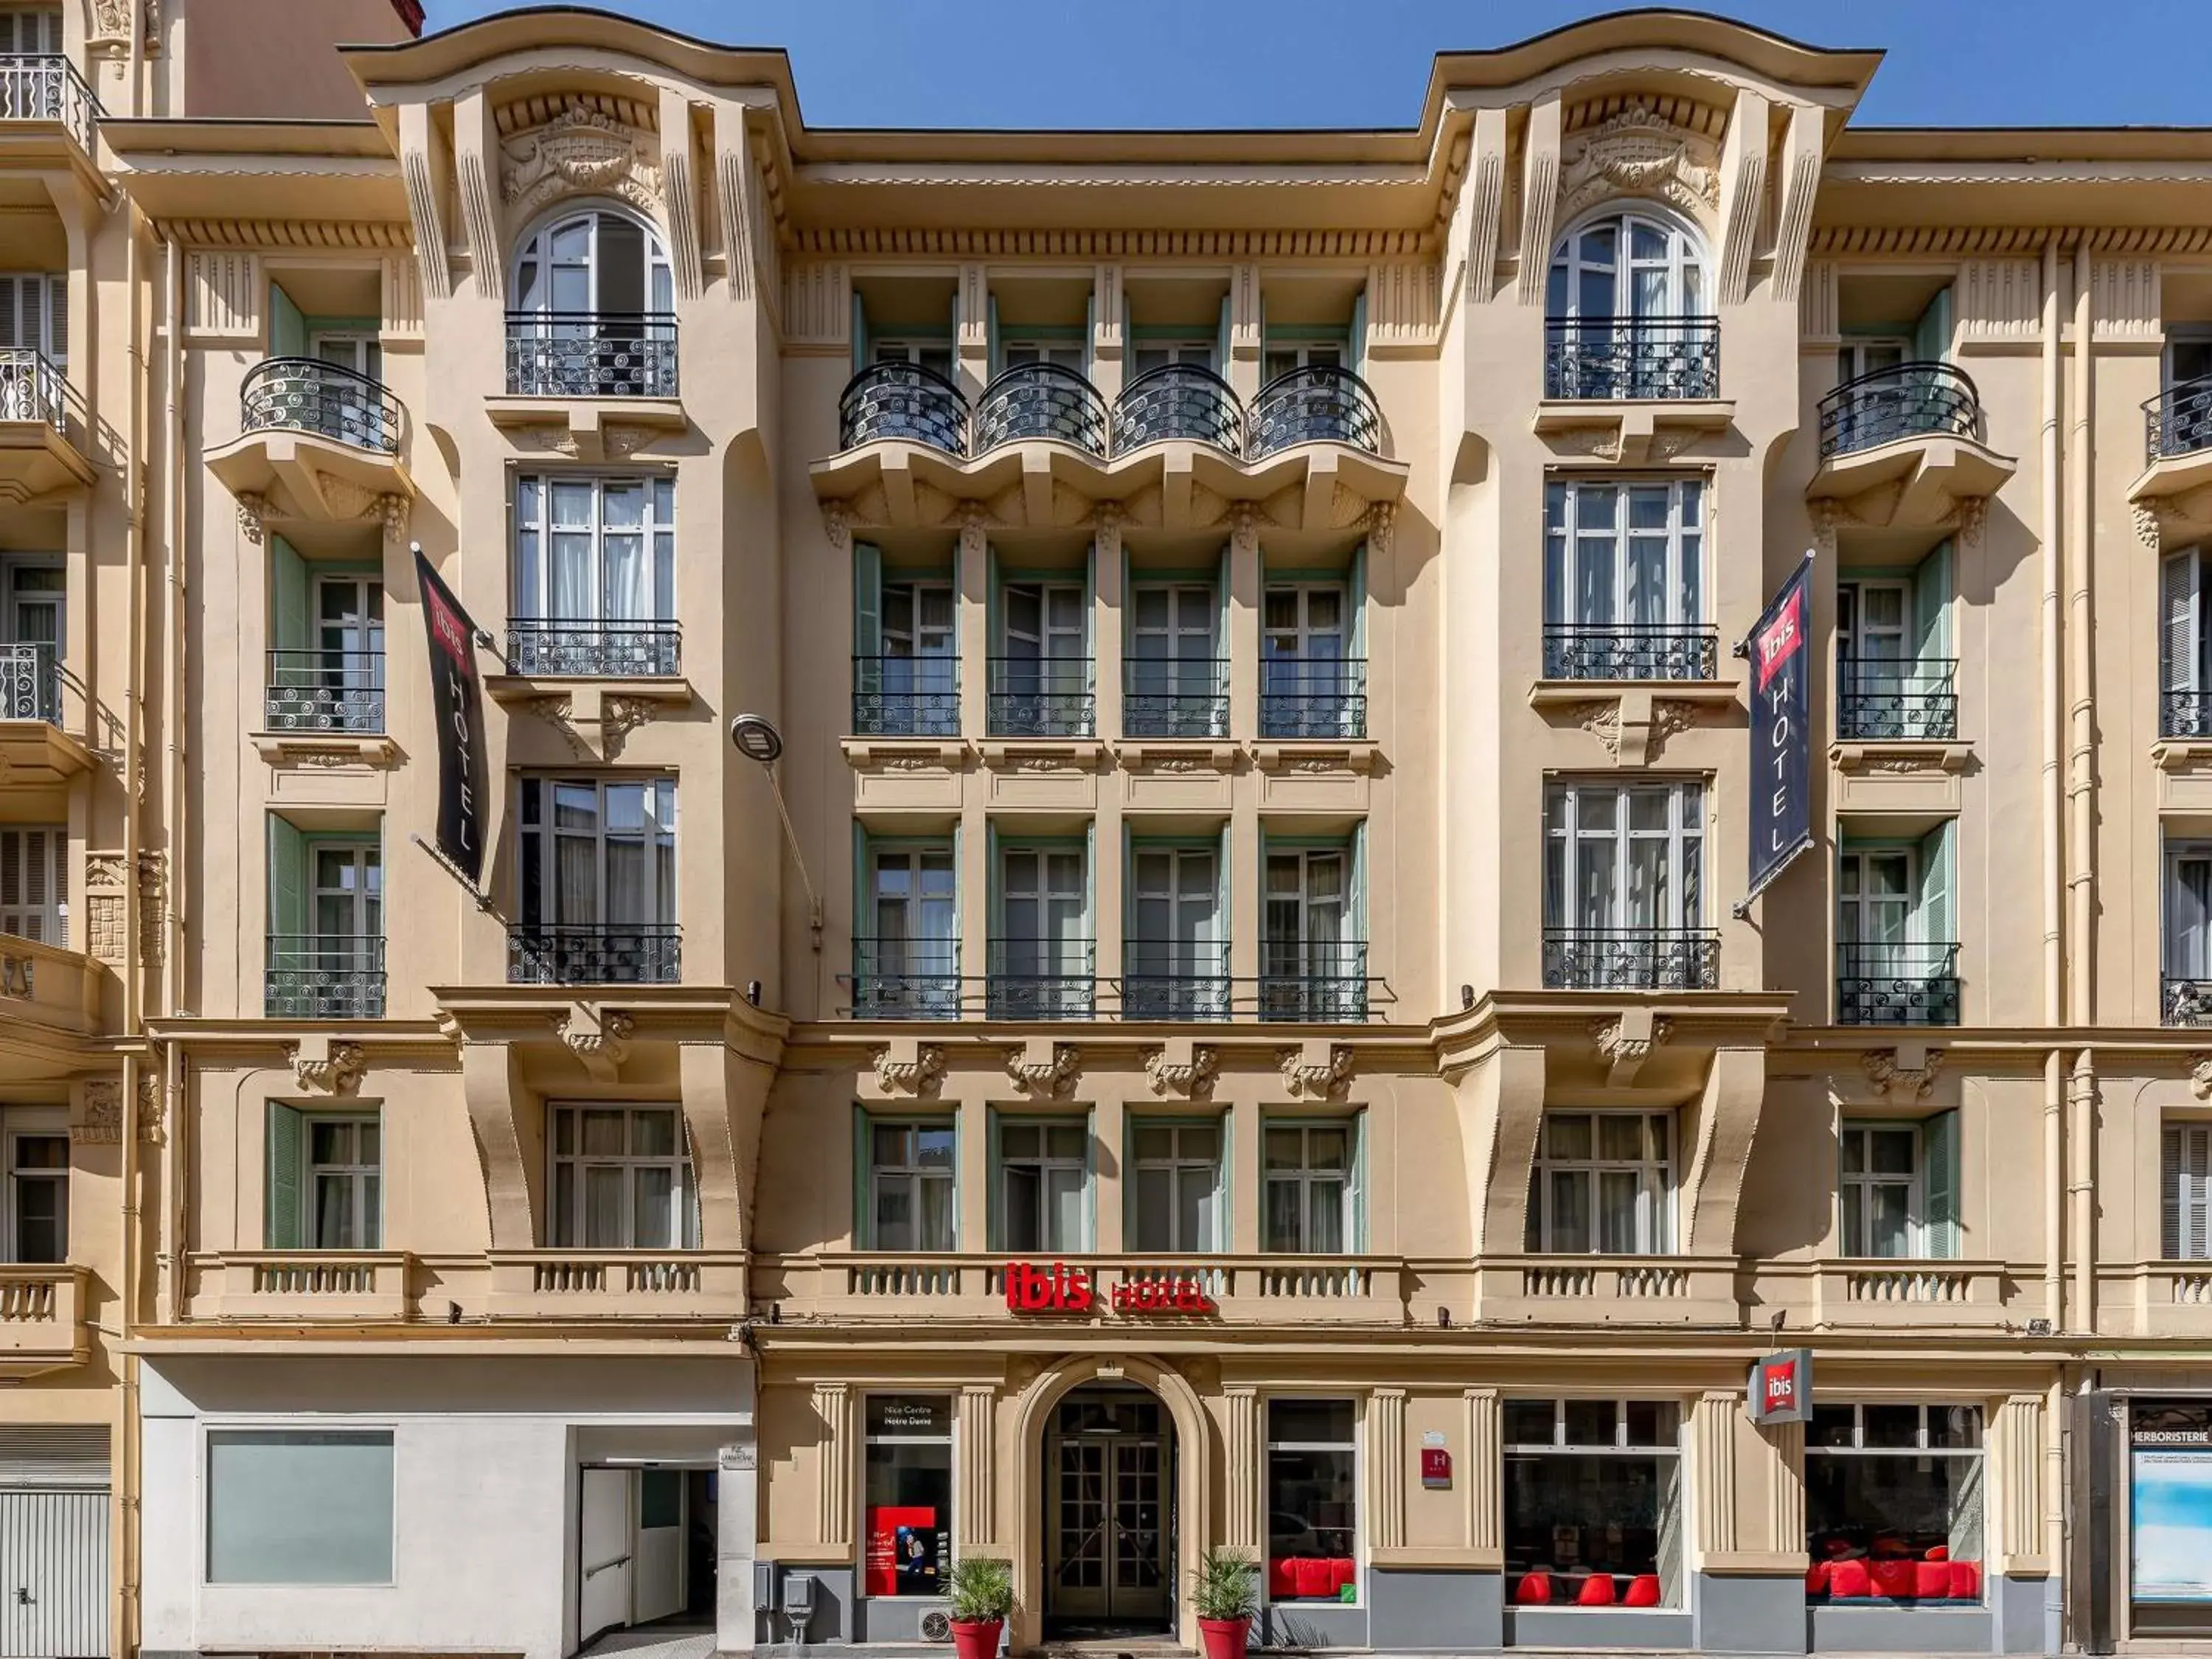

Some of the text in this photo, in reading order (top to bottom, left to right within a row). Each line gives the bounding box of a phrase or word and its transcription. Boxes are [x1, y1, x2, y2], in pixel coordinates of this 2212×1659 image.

[436, 605, 464, 656] ibis
[1764, 619, 1794, 664] ibis
[450, 672, 473, 850] HOTEL
[1772, 678, 1789, 852] HOTEL
[1005, 1262, 1213, 1311] ibis HOTEL
[1769, 1376, 1791, 1397] ibis
[885, 1417, 908, 1425] Notre
[2130, 1431, 2208, 1441] HERBORISTERIE
